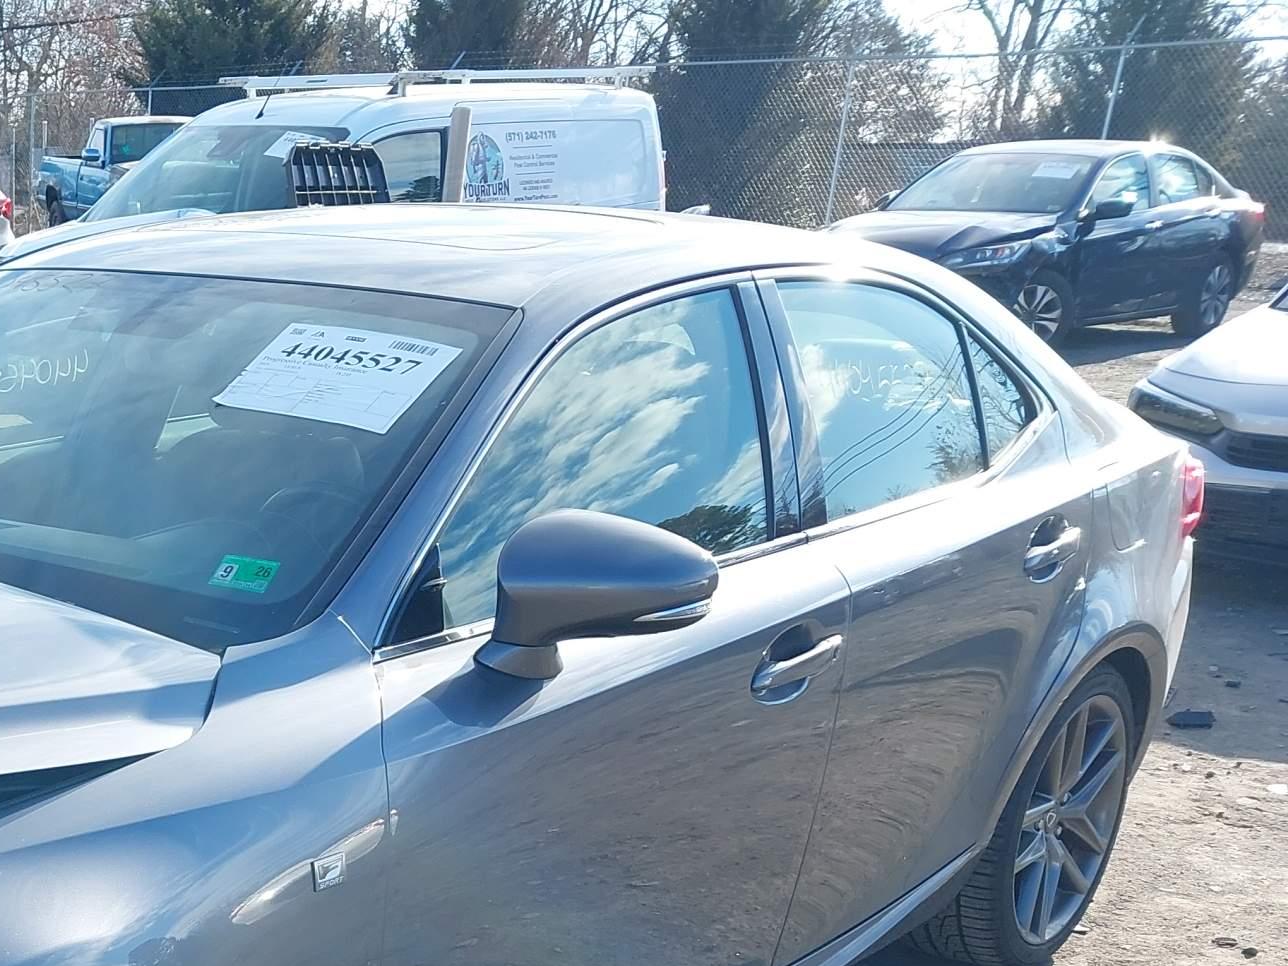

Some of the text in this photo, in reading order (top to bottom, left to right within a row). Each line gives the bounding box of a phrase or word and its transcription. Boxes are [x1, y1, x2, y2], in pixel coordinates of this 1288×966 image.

[281, 342, 423, 375] 44045527
[220, 565, 234, 578] 9
[255, 566, 273, 578] 26
